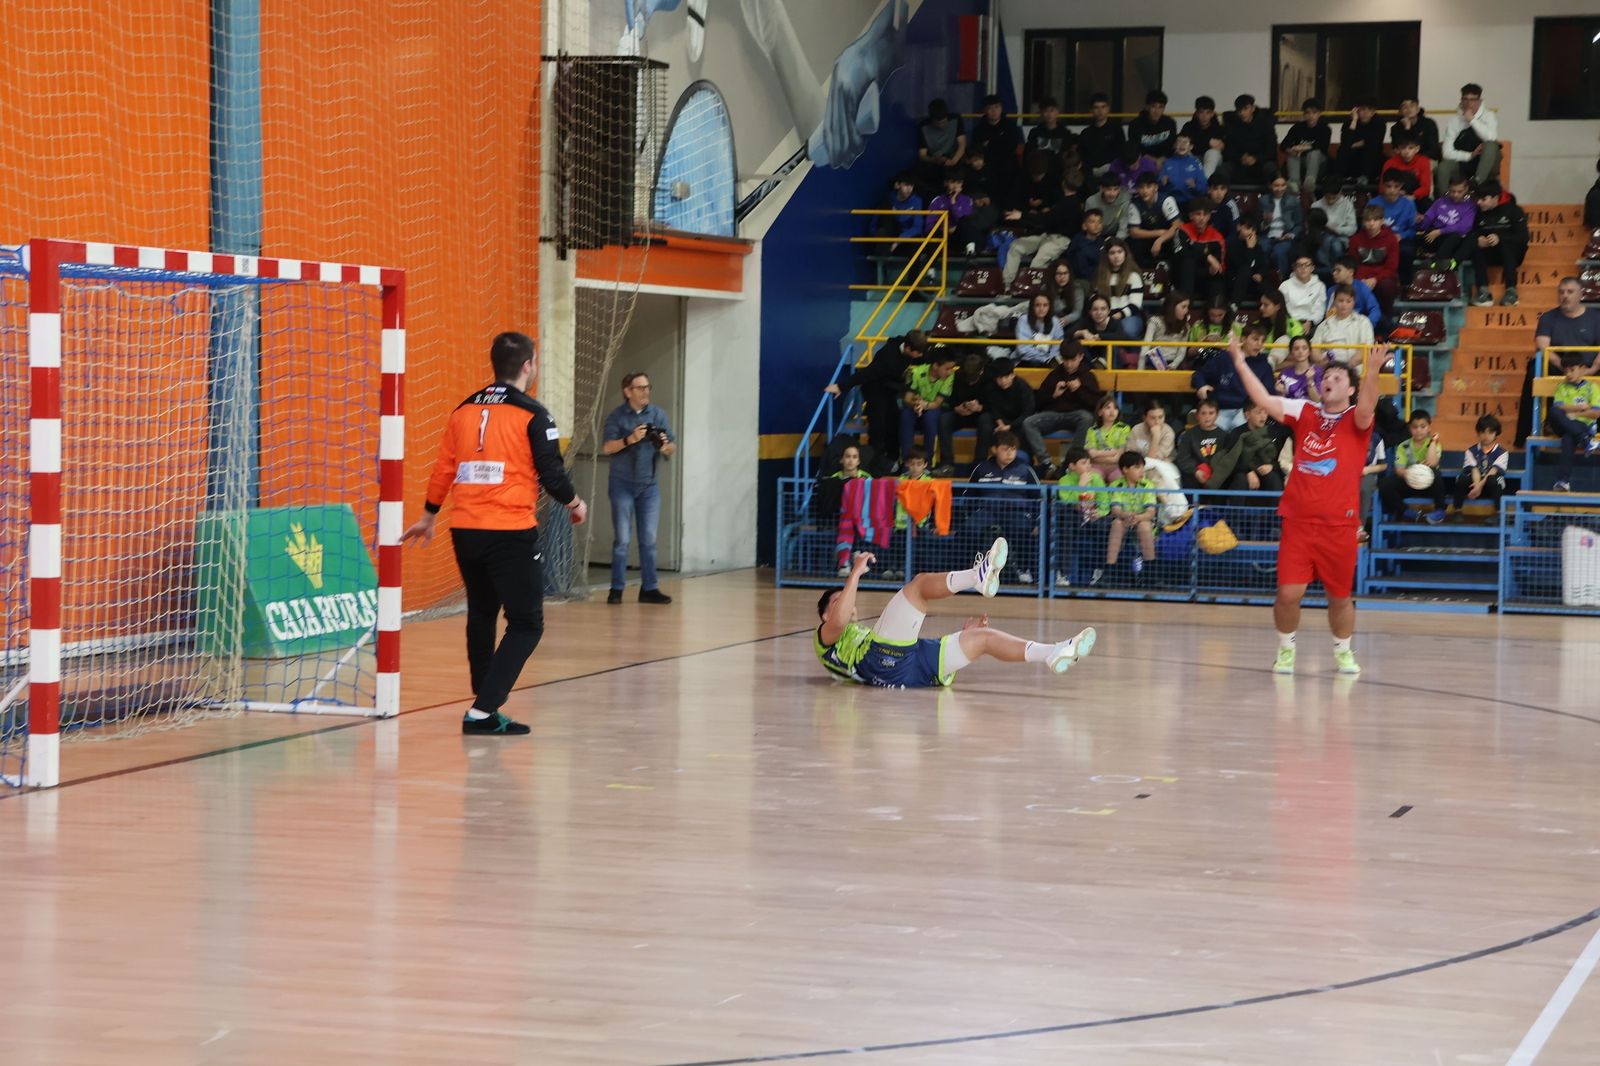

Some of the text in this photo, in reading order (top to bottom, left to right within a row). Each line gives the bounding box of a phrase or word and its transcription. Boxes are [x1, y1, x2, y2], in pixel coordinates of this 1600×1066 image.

[1528, 230, 1557, 244] ILA
[1485, 312, 1527, 327] FILA
[1474, 356, 1517, 371] FILA
[1460, 401, 1504, 417] FILA
[476, 408, 491, 452] 1
